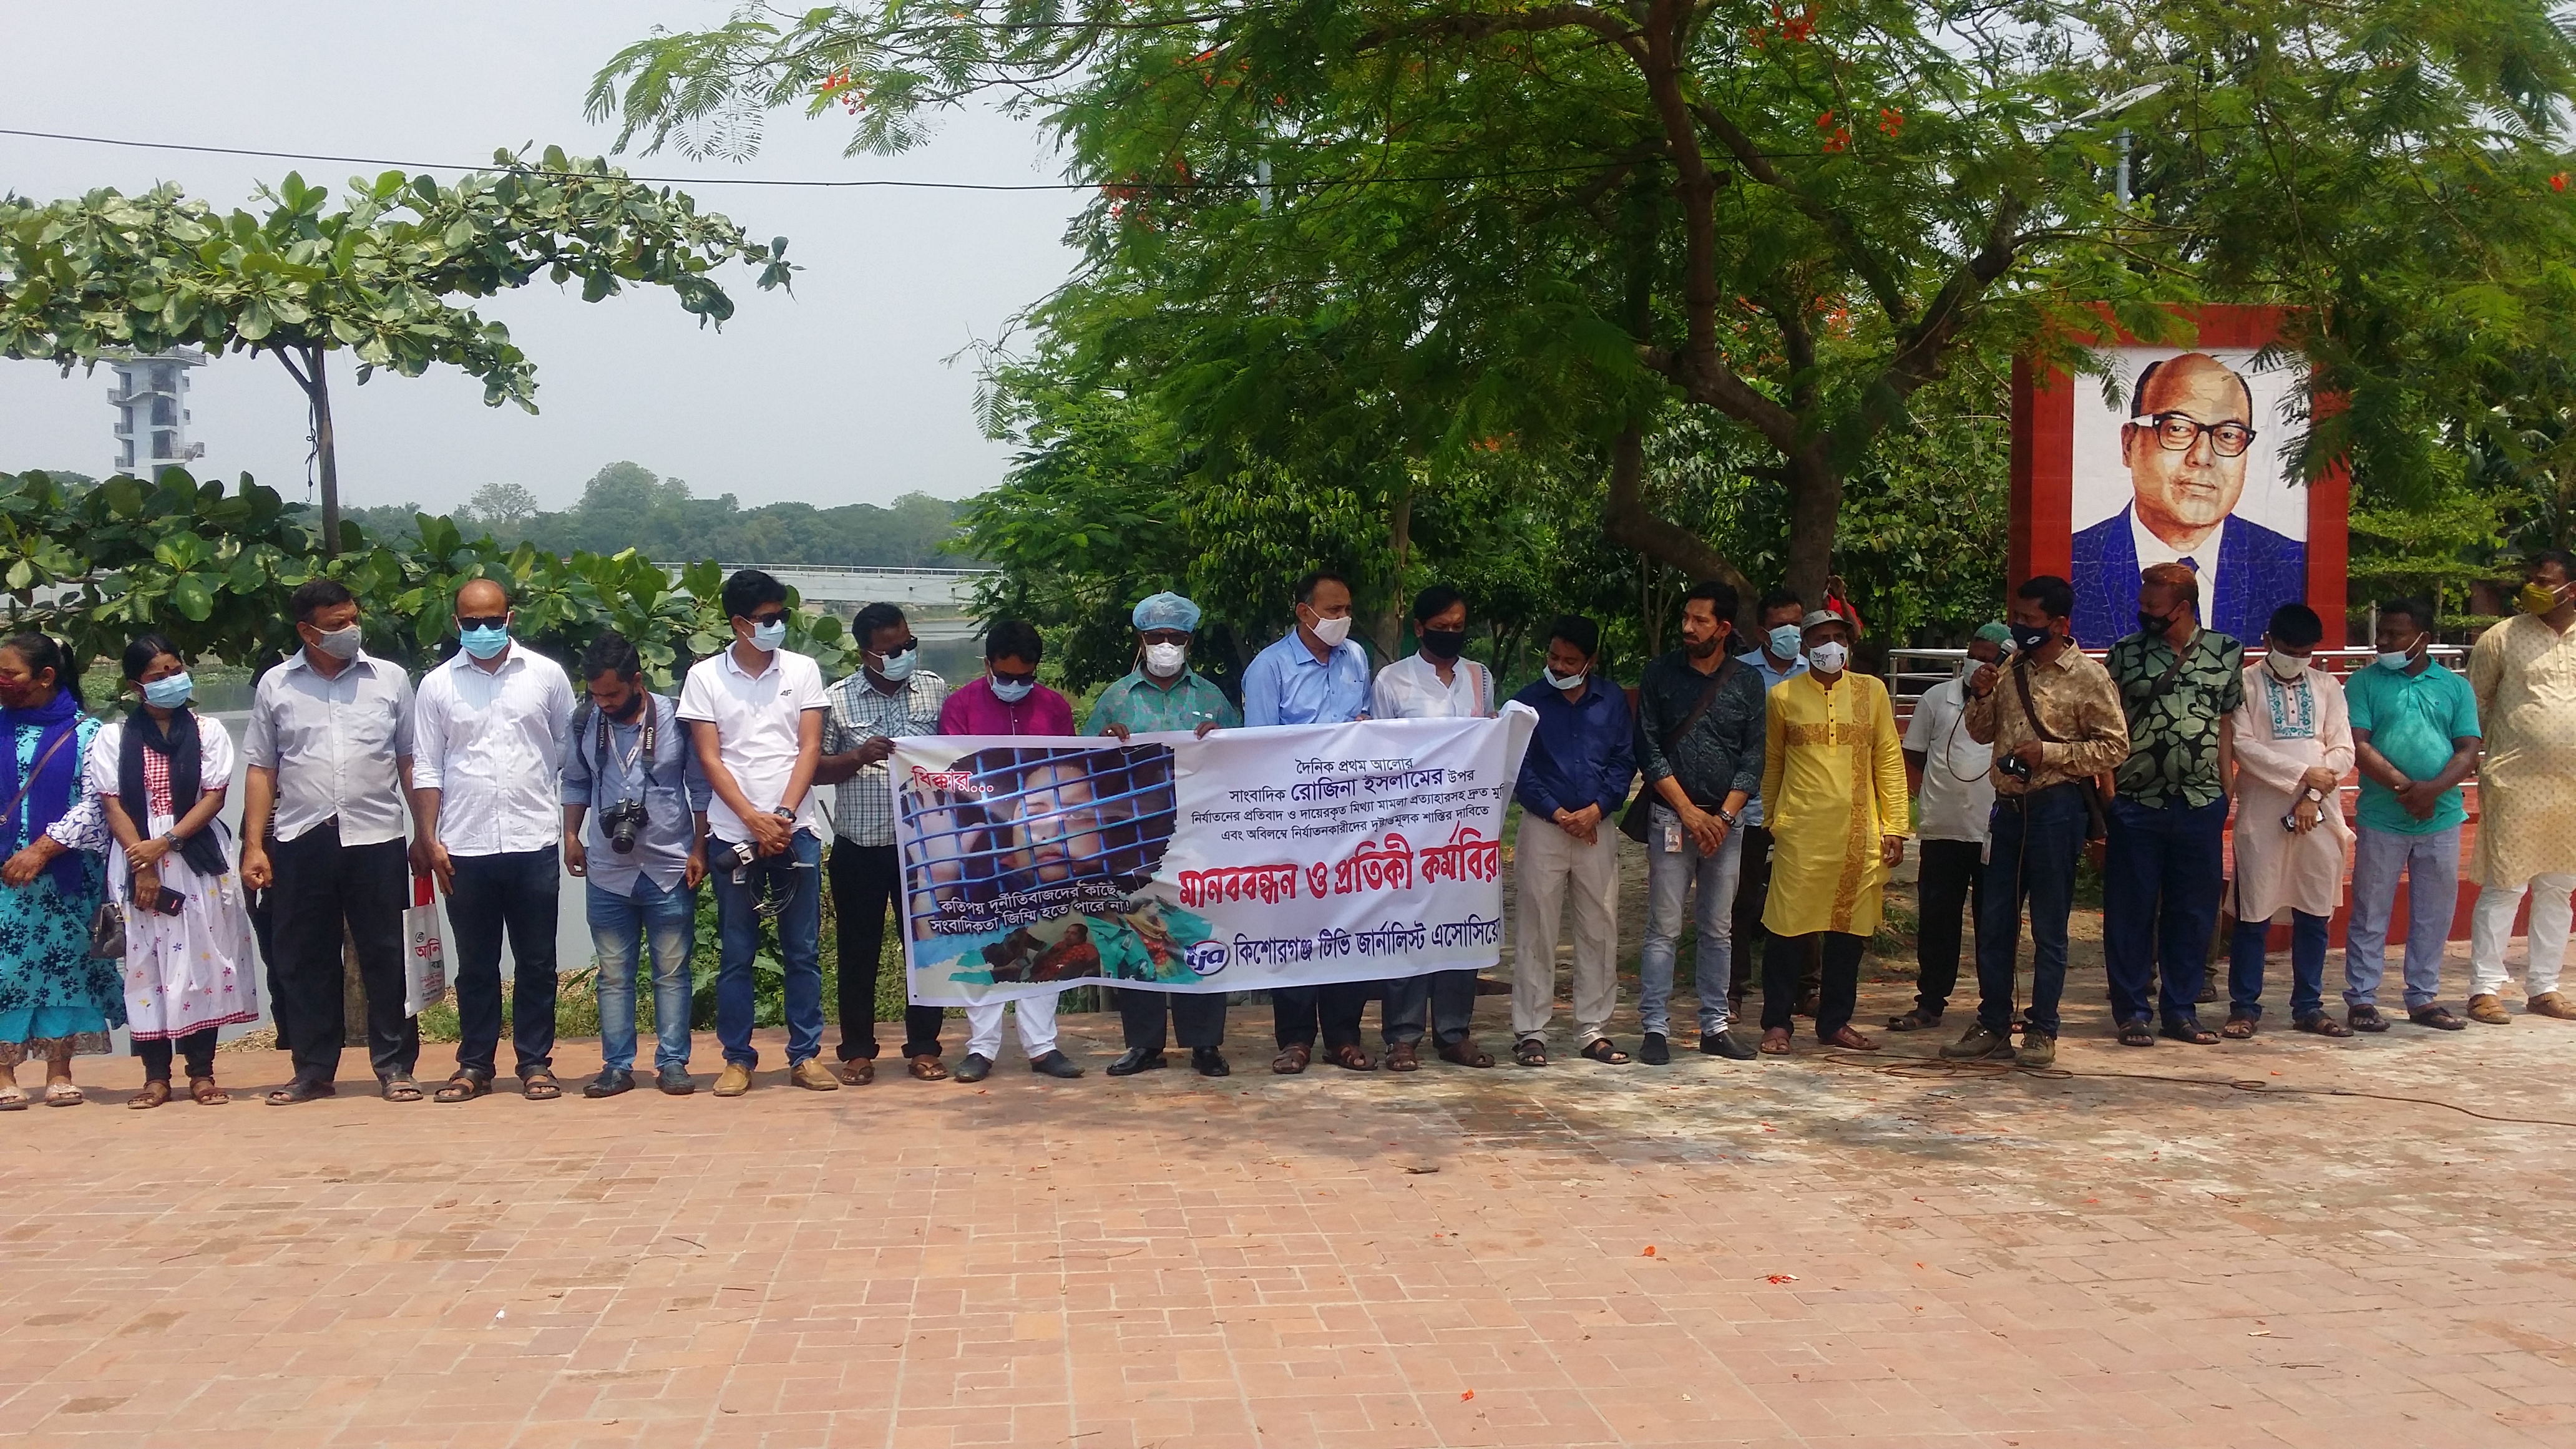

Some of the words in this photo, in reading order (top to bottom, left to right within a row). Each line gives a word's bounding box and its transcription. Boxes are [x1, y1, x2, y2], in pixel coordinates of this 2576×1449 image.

[645, 726, 654, 749] Canon
[1295, 758, 1335, 774] দৈনিক
[1339, 759, 1367, 774] প্রথম
[1370, 758, 1413, 771] আলোর
[1229, 786, 1286, 803] সাংবাদিক
[1291, 776, 1358, 801] রোজিনা
[1364, 768, 1445, 794] ইসলামের
[1448, 769, 1475, 783] উপর
[1191, 809, 1241, 824] নির্যাতনের
[1244, 807, 1284, 821] প্রতিবাদ
[1287, 811, 1296, 820] ও
[1300, 805, 1347, 821] দায়েরকৃত
[1350, 801, 1374, 814] মিথ্যা
[1377, 797, 1407, 811] মামলা
[1410, 790, 1466, 806] প্রত্যাহারসহ
[1468, 788, 1489, 800] দ্রুত
[1221, 831, 1244, 841] এবং
[1246, 826, 1288, 840] অবিলম্বে
[1290, 820, 1367, 839] নির্যাতনকারীদের
[1423, 809, 1453, 824] শাস্তির
[1456, 804, 1490, 819] দাবিতে
[1178, 863, 1298, 908] মানববন্ধন
[1305, 861, 1328, 899] ও
[1334, 832, 1414, 894] প্রতিকী
[1420, 820, 1500, 884] কর্মবির
[939, 897, 985, 915] কতিপয়
[1083, 884, 1118, 897] কাছে
[1002, 909, 1037, 926] জিম্মি
[1040, 903, 1070, 920] হতে
[1073, 900, 1105, 913] পারে
[1109, 899, 1130, 913] না!
[1233, 933, 1313, 967] কিশোরগঞ্জ
[1318, 927, 1352, 960] টিভি
[1355, 920, 1427, 957] জার্নালিস্ট
[1432, 914, 1500, 948] এসোসিয়ে
